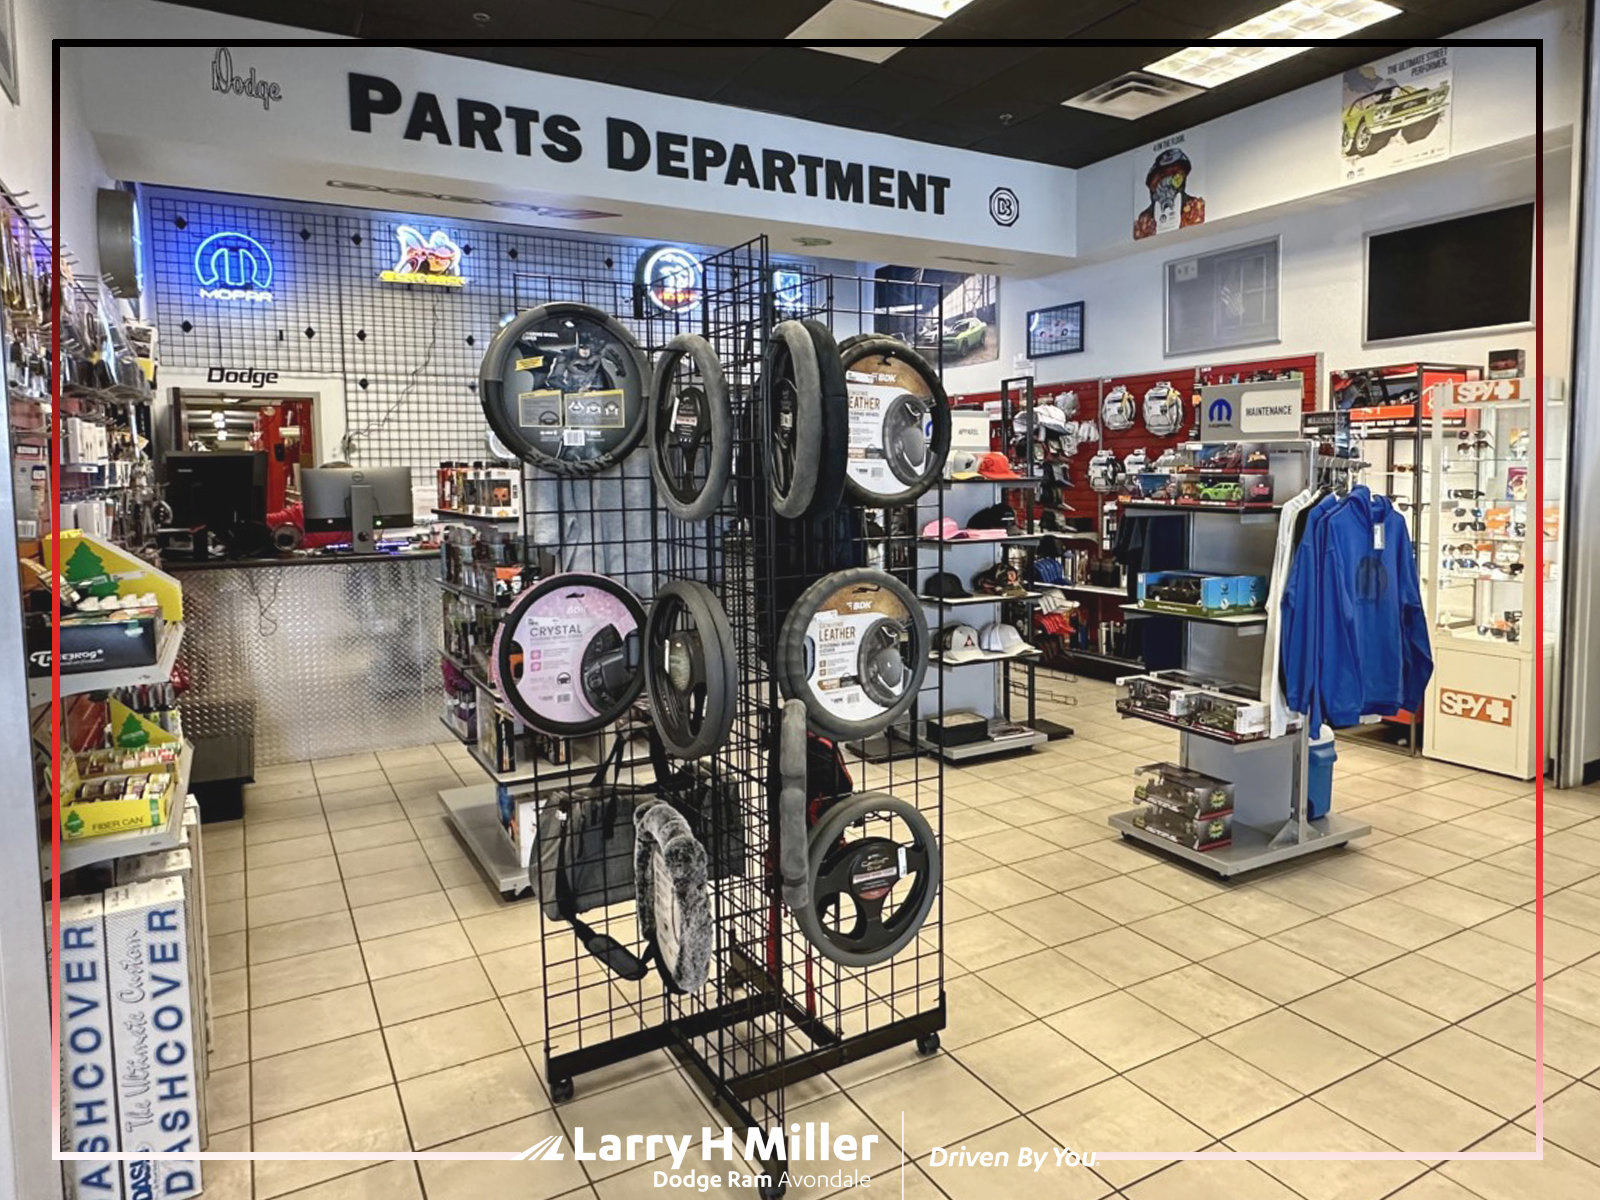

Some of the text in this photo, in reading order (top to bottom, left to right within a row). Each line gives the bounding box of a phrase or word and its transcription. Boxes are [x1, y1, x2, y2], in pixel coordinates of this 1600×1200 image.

[1387, 47, 1448, 75] THE ULTIMATE STREET
[212, 47, 282, 110] Dodge
[347, 71, 951, 216] PARTS DEPARTMENT
[199, 288, 273, 302] MOPAR
[207, 367, 278, 388] Dodge
[1246, 405, 1293, 417] MAINTENANCE
[530, 624, 582, 637] CRYSTAL
[819, 626, 856, 642] LEATHER
[92, 816, 144, 831] FIBER CAN
[121, 1011, 151, 1098] Ultimate
[147, 908, 196, 1195] DASHCOVER
[124, 1099, 154, 1134] The
